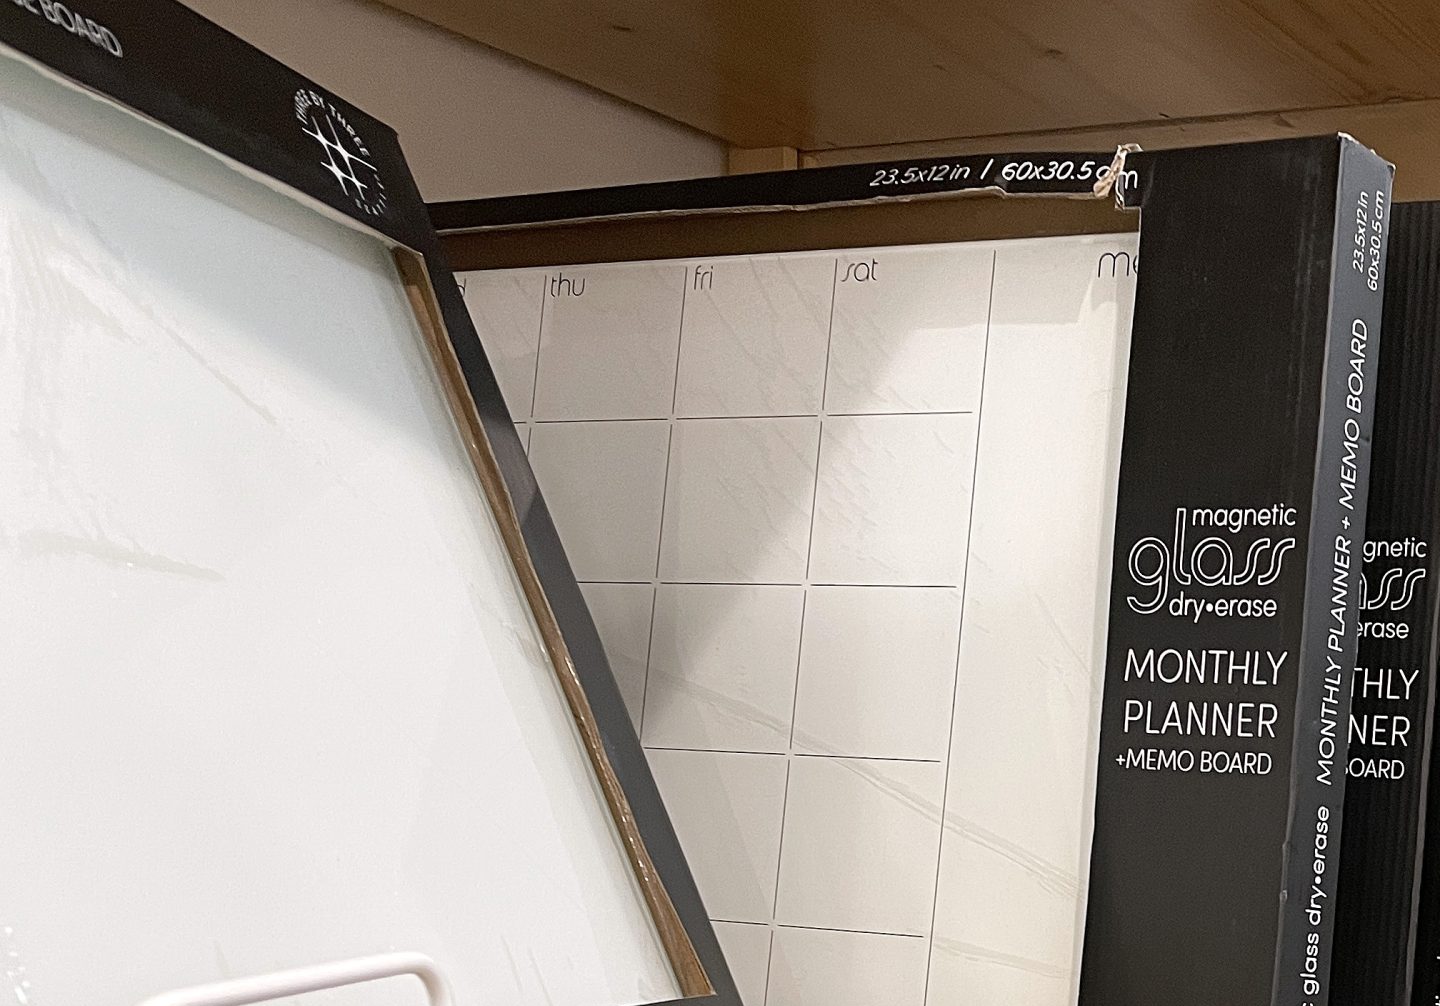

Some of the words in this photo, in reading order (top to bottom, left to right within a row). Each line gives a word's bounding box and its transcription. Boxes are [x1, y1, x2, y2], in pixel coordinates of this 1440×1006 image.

[41, 0, 123, 58] BOARD
[870, 164, 970, 187] 23.5x12in
[1353, 191, 1369, 274] 23.5x12in
[1367, 190, 1385, 291] 60x30.5cm
[550, 272, 585, 297] thu
[694, 265, 713, 290] fri
[841, 258, 878, 282] sat
[1346, 319, 1368, 412] BOARD
[1339, 419, 1361, 509] MEMO
[1192, 503, 1297, 533] magnetic
[1127, 507, 1296, 614] glass
[1363, 537, 1427, 562] gnetic
[1169, 591, 1278, 623] dry•erase
[1328, 535, 1351, 652] PLANNER
[1124, 649, 1287, 685] MONTHLY
[1124, 700, 1278, 738] PLANNER
[1316, 656, 1342, 785] MONTHLY
[1116, 748, 1194, 772] +MEMO
[1200, 751, 1272, 775] BOARD
[1345, 758, 1405, 780] OARD
[1305, 805, 1330, 926] dry•erase
[1300, 933, 1320, 995] glass
